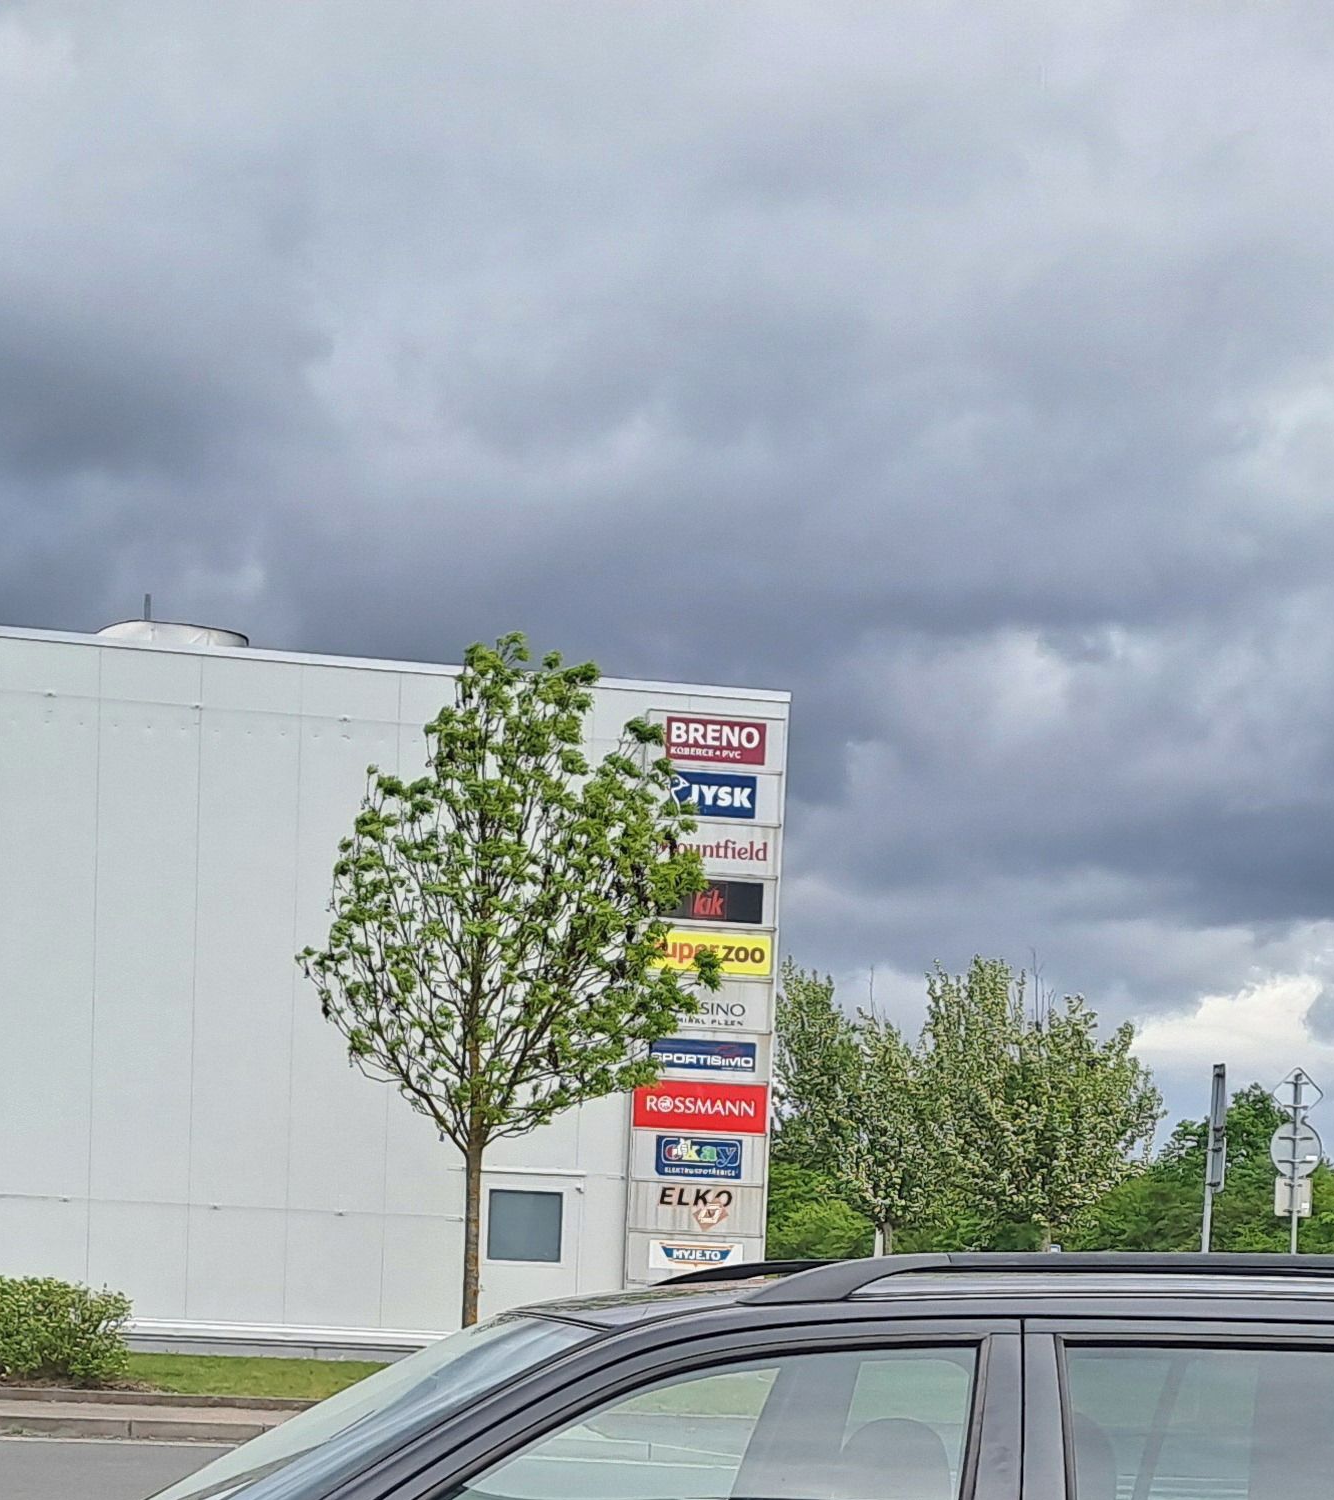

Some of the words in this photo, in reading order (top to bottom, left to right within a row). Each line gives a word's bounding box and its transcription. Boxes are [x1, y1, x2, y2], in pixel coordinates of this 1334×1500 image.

[671, 722, 760, 749] BRENO
[670, 746, 714, 757] KOBERCE
[722, 750, 741, 759] PVC
[687, 784, 752, 808] JYSK
[646, 1095, 755, 1118] ROSSMANN
[659, 1187, 733, 1208] ELKO
